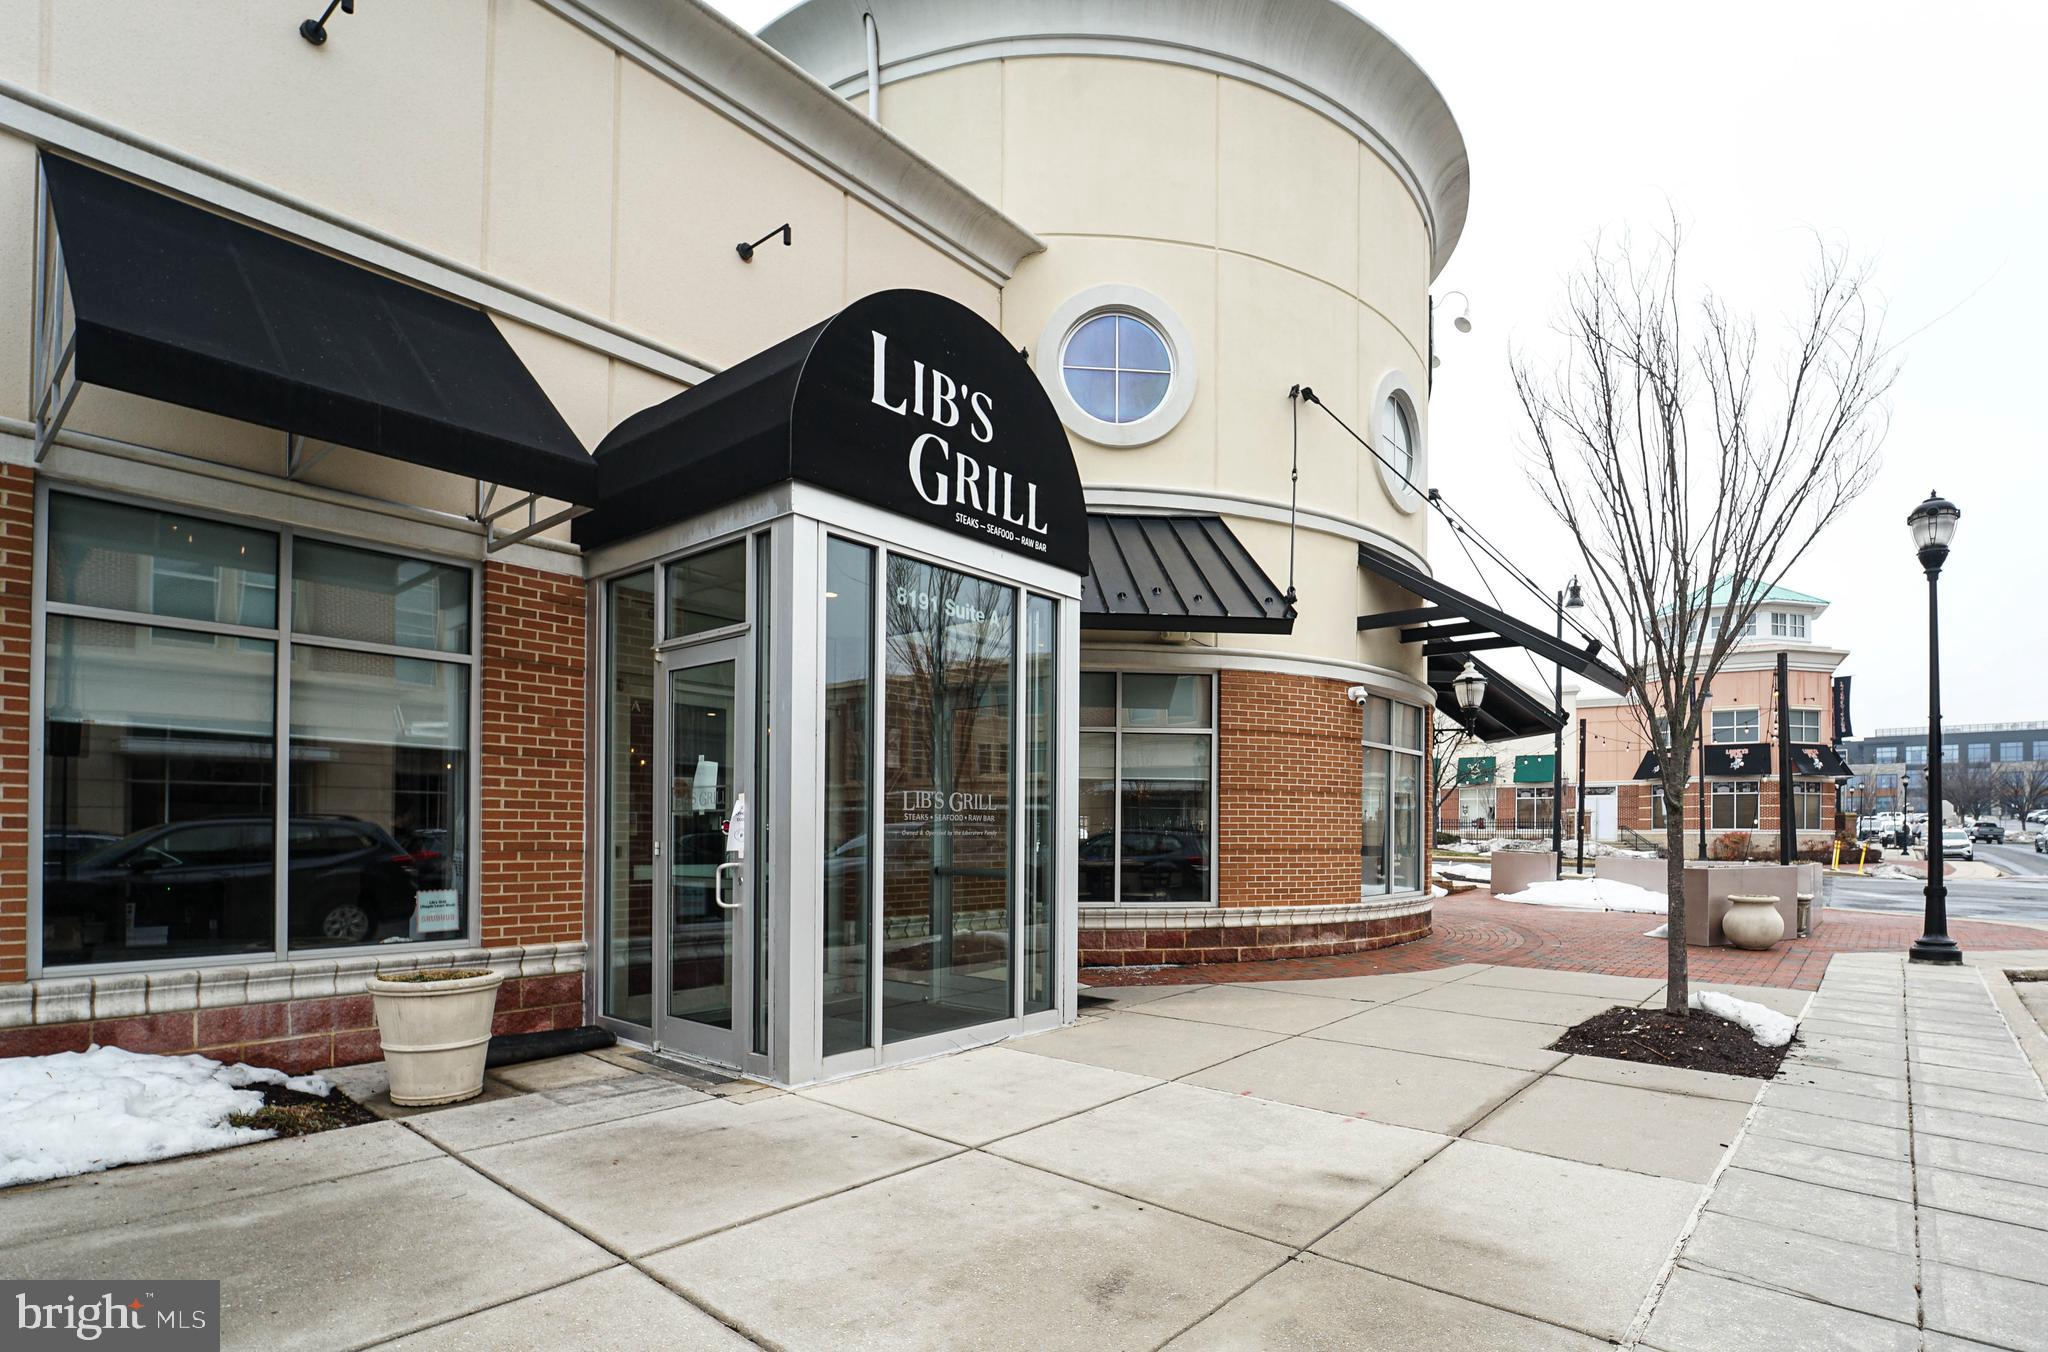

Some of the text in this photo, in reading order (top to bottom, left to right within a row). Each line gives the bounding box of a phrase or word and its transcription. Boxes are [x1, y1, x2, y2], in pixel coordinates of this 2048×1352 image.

[871, 330, 993, 443] LIB'S
[909, 433, 1048, 534] GRILL
[955, 512, 1047, 552] STEAKS SEAFOOD RAW BAR
[897, 586, 1000, 628] 8191 Suite A
[902, 790, 997, 812] LIB'S GRILL
[903, 813, 929, 821] STEAKS
[934, 813, 964, 822] SEAFOOD
[968, 814, 982, 822] RAW
